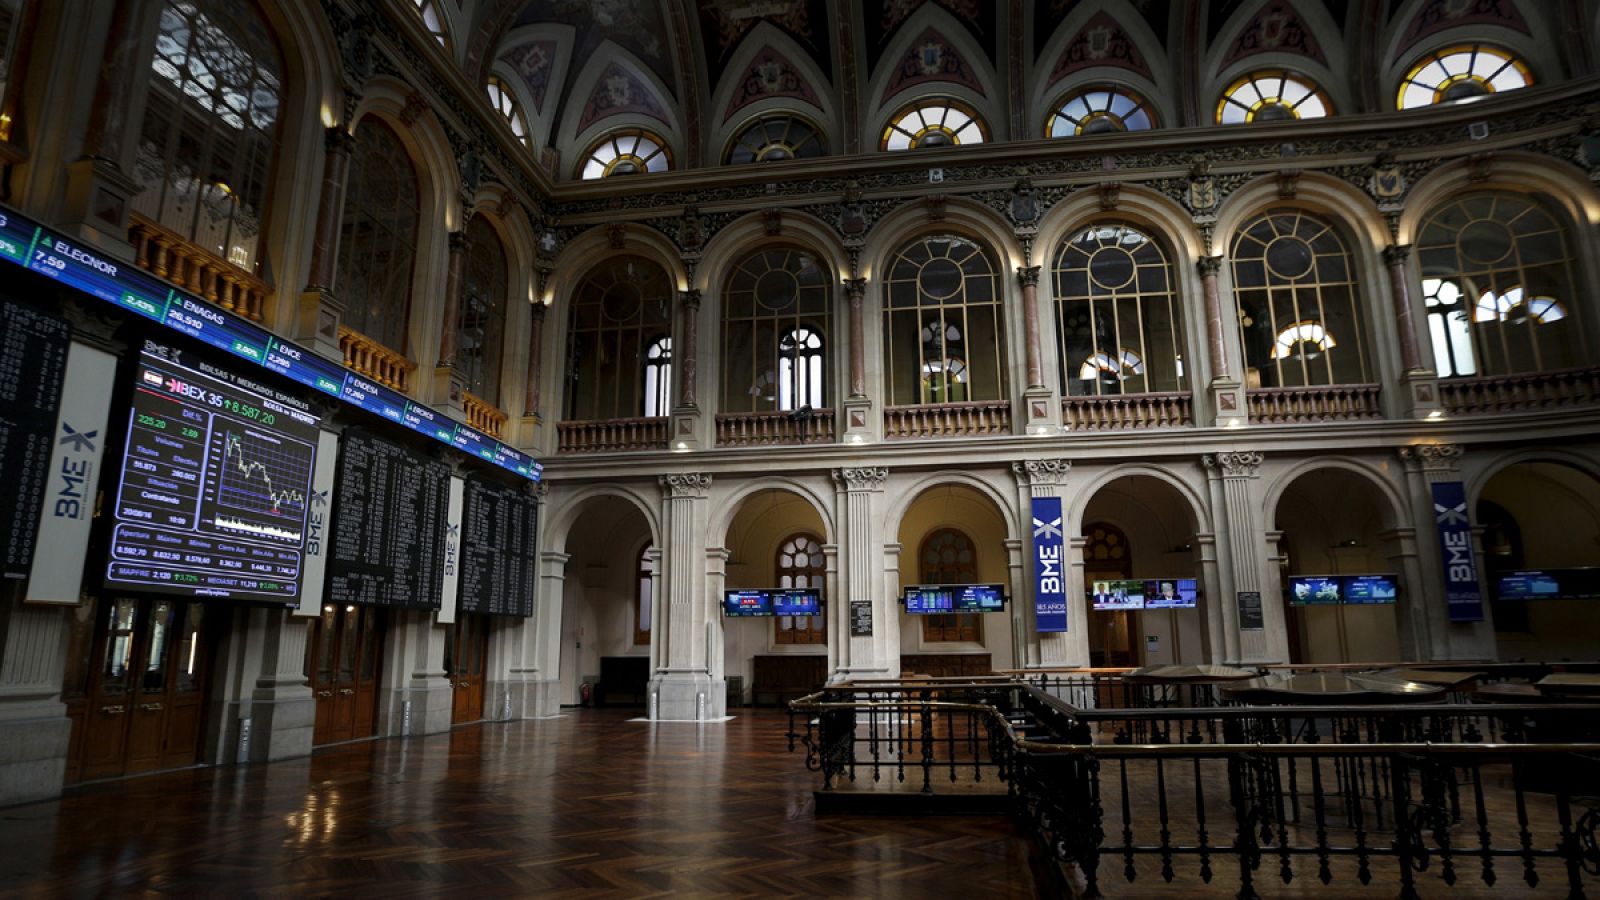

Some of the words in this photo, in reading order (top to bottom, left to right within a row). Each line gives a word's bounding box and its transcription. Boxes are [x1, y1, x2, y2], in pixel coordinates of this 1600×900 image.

[35, 250, 66, 270] 7,59
[54, 240, 118, 277] ELECNOR
[183, 300, 225, 326] ENAGAS
[278, 344, 301, 362] ENCE
[176, 380, 207, 402] IBEX
[207, 392, 224, 408] 35
[199, 361, 229, 380] BOLSAS
[230, 372, 236, 382] Y
[236, 376, 274, 397] MERCADOS
[275, 391, 309, 411] ESPAÑOLES
[353, 379, 378, 396] ENDESA
[291, 410, 315, 425] MADRID
[54, 456, 87, 520] BME
[306, 511, 323, 556] BME
[445, 542, 455, 577] BME
[1039, 545, 1060, 594] BME
[1443, 530, 1472, 583] BME
